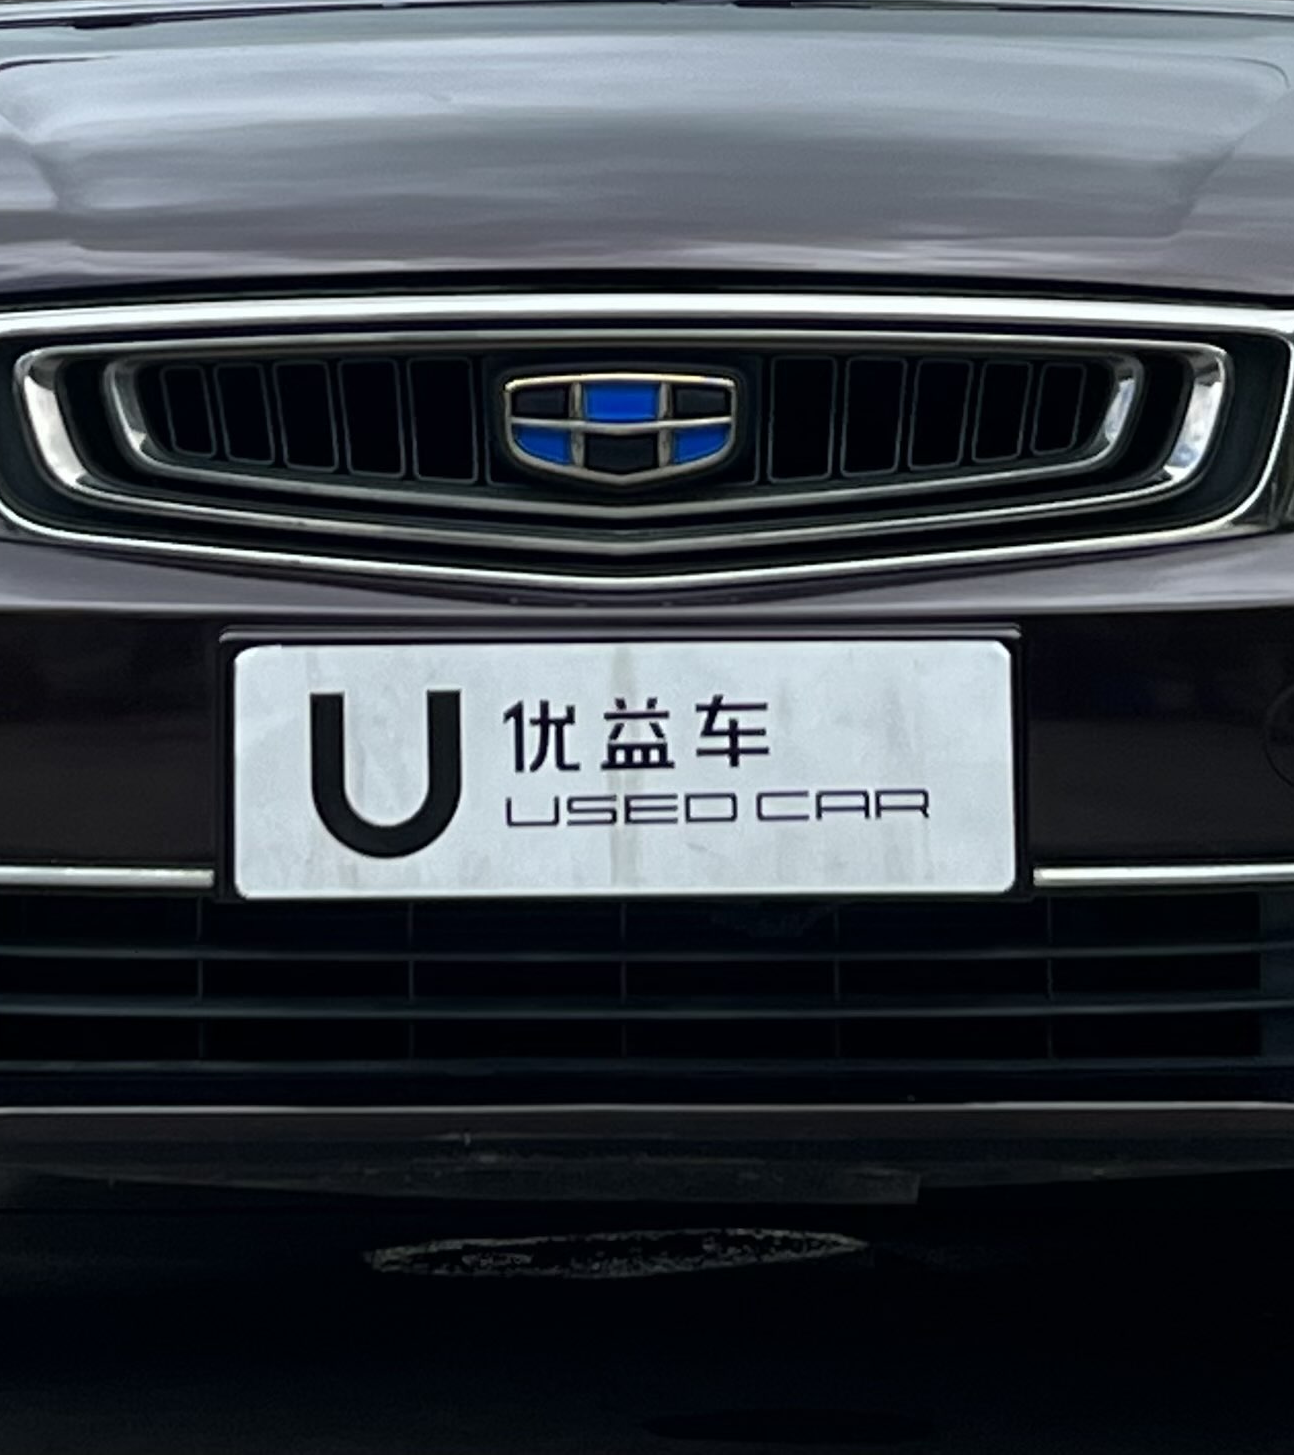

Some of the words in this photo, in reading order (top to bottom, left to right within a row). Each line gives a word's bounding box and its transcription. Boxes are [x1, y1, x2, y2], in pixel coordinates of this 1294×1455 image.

[503, 694, 770, 773] 优益车
[309, 689, 463, 860] U
[505, 792, 739, 828] USED
[755, 788, 930, 823] CAR
